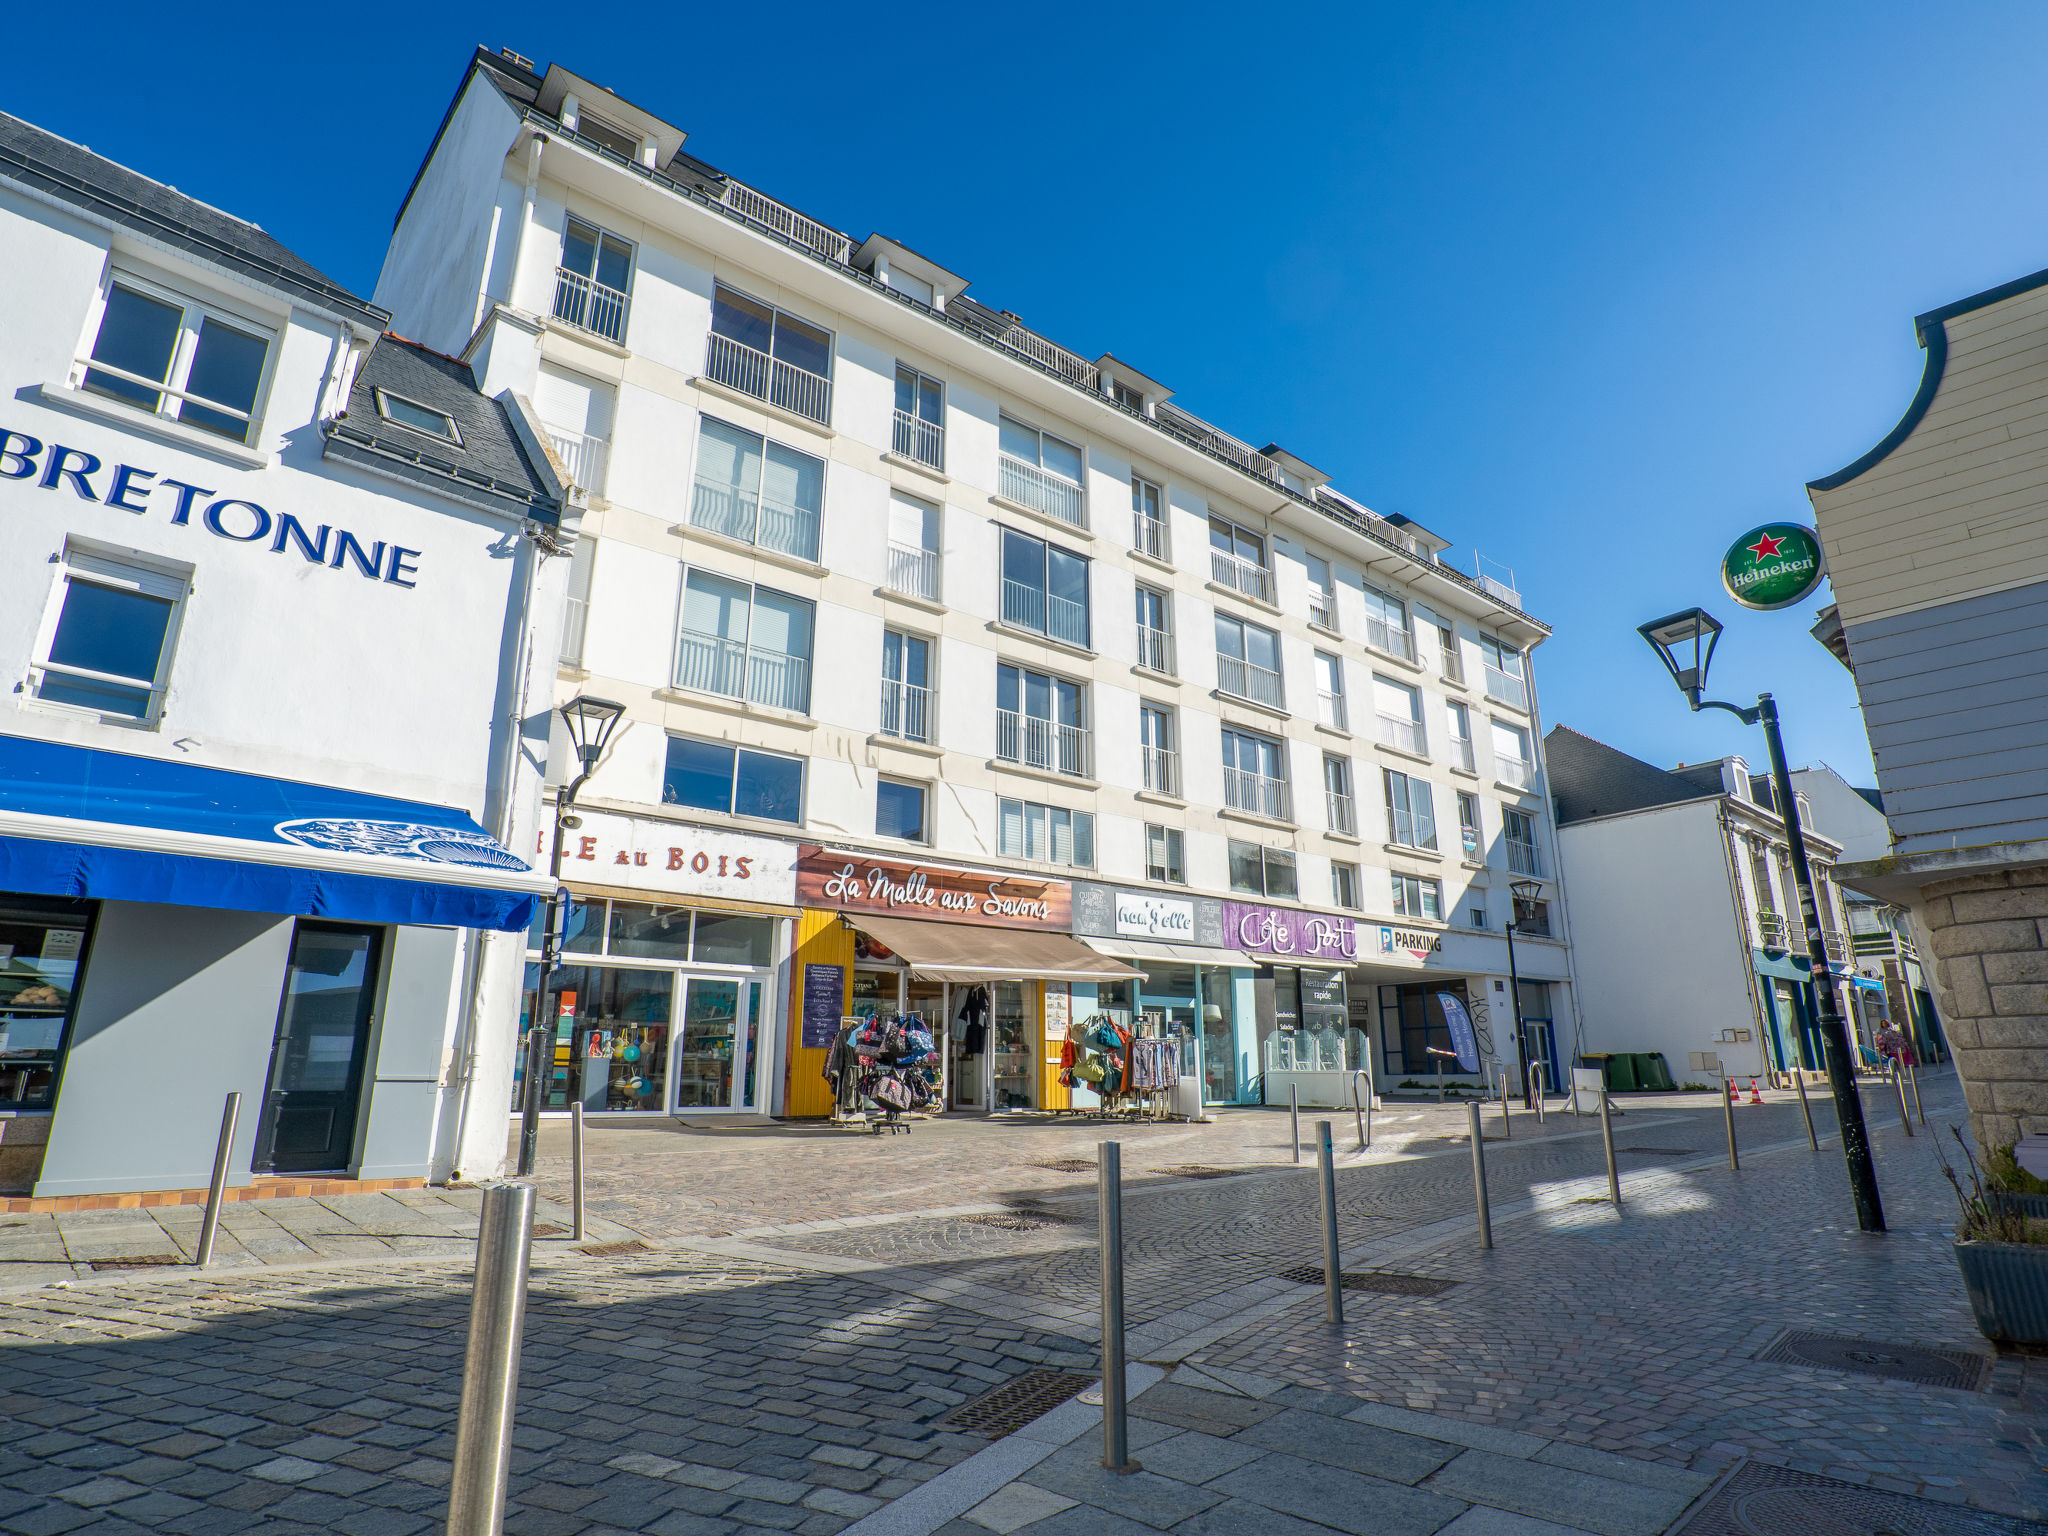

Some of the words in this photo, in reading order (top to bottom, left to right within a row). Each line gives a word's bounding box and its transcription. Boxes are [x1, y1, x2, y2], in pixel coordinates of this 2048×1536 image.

[0, 427, 423, 589] BRETONNE
[1733, 558, 1814, 588] Heineken
[666, 846, 753, 880] BOIS
[825, 863, 862, 903] La
[867, 867, 936, 907] Malle
[941, 891, 977, 912] aux
[983, 882, 1051, 919] Savons
[1304, 919, 1357, 957] Port
[1394, 931, 1441, 952] PARKING
[1314, 991, 1332, 1001] rapide
